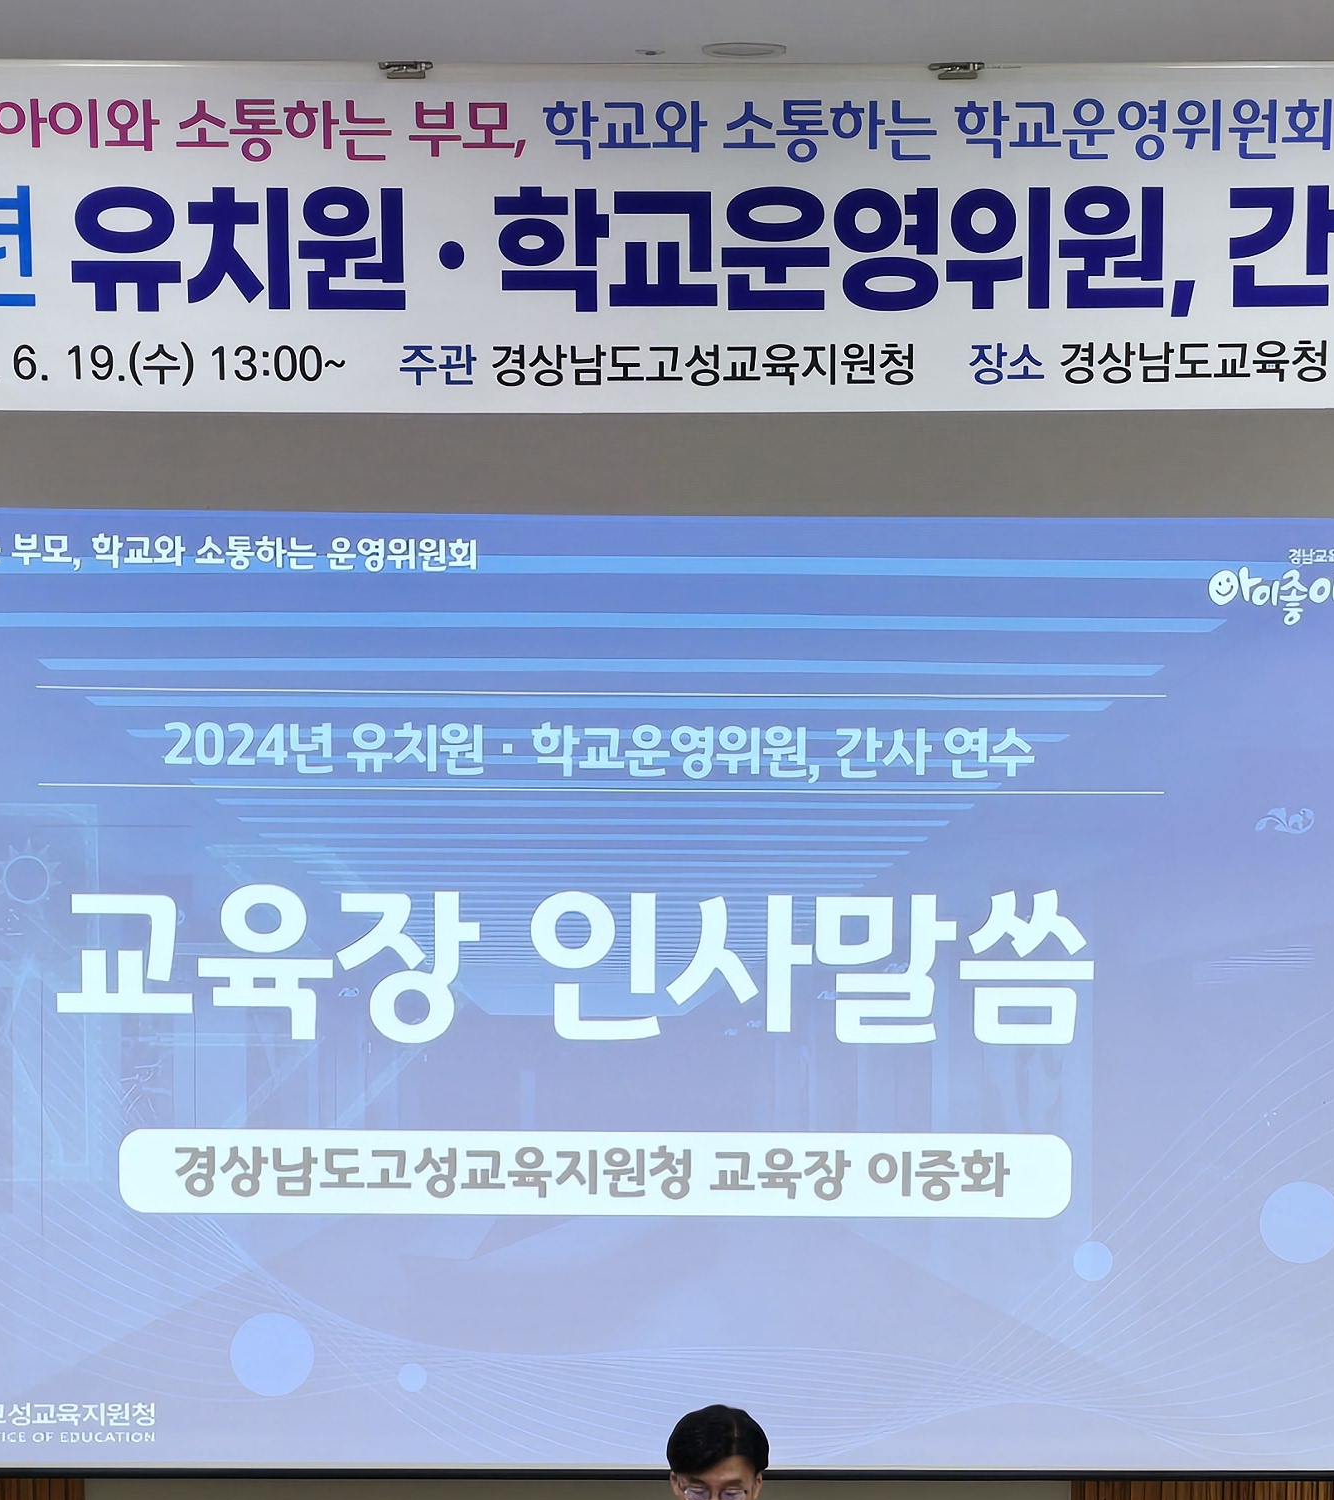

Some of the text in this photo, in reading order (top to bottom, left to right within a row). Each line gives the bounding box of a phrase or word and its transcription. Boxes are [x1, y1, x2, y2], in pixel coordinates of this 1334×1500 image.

[176, 98, 393, 163] 소통하는
[408, 101, 526, 159] 부모,
[542, 100, 708, 159] 학교와
[723, 99, 938, 163] 소통하는
[954, 98, 1333, 161] 학교운영위원회
[71, 186, 406, 313] 유치원
[13, 344, 49, 381] 6.
[67, 341, 194, 387] 19.(수)
[211, 344, 346, 382] 13:00~
[399, 344, 478, 386] 주관
[492, 343, 914, 387] 경상남도고성교육지원청
[969, 342, 1045, 385] 장소
[1060, 339, 1327, 385] 경상남도교육청
[11, 533, 81, 571] 부모,
[91, 532, 186, 569] 학교와
[194, 535, 317, 570] 소통하는
[326, 537, 477, 572] 운영위원회
[161, 721, 334, 774] 2024년
[346, 721, 484, 776] 유치원
[835, 727, 933, 779] 간사
[943, 727, 1036, 779] 연수
[56, 884, 1095, 1045] 교육장 인사말씀
[174, 1144, 1011, 1202] 경상남도고성교육지원청 교육장 이중화
[32, 1431, 54, 1443] OF
[60, 1431, 156, 1443] EDUCATION
